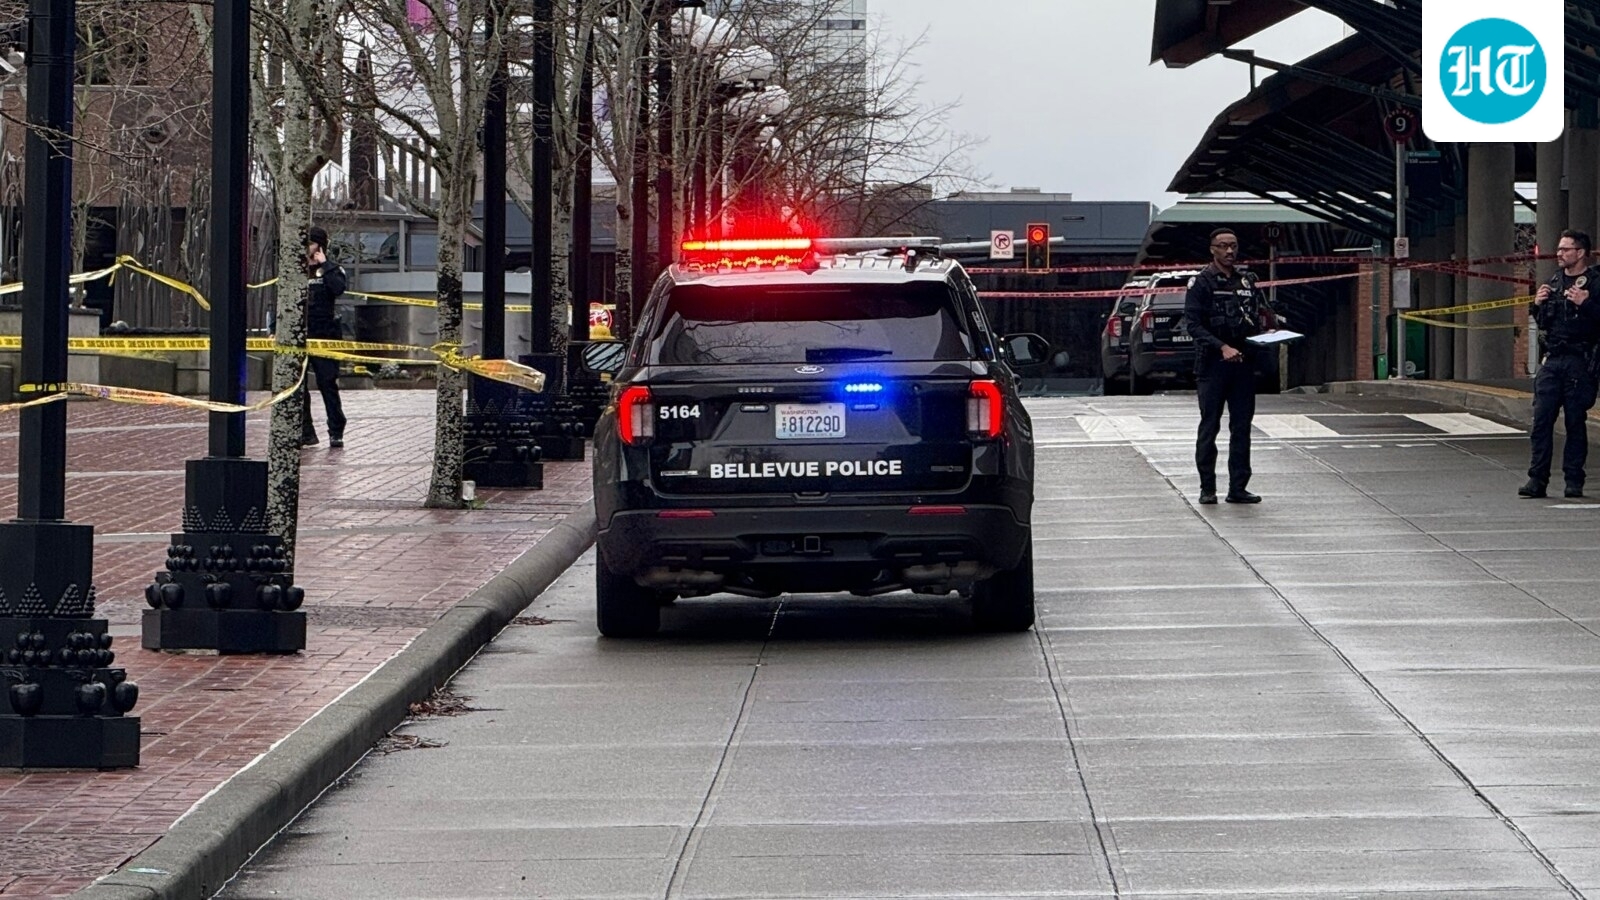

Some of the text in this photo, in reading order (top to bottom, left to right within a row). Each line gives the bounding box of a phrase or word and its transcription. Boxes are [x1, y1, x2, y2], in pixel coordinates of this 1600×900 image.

[1395, 117, 1407, 132] 9
[1267, 227, 1280, 238] 10
[659, 405, 701, 419] 5164
[789, 415, 841, 433] 81229D
[710, 461, 819, 479] BELLEVUE
[825, 460, 902, 476] POLICE
